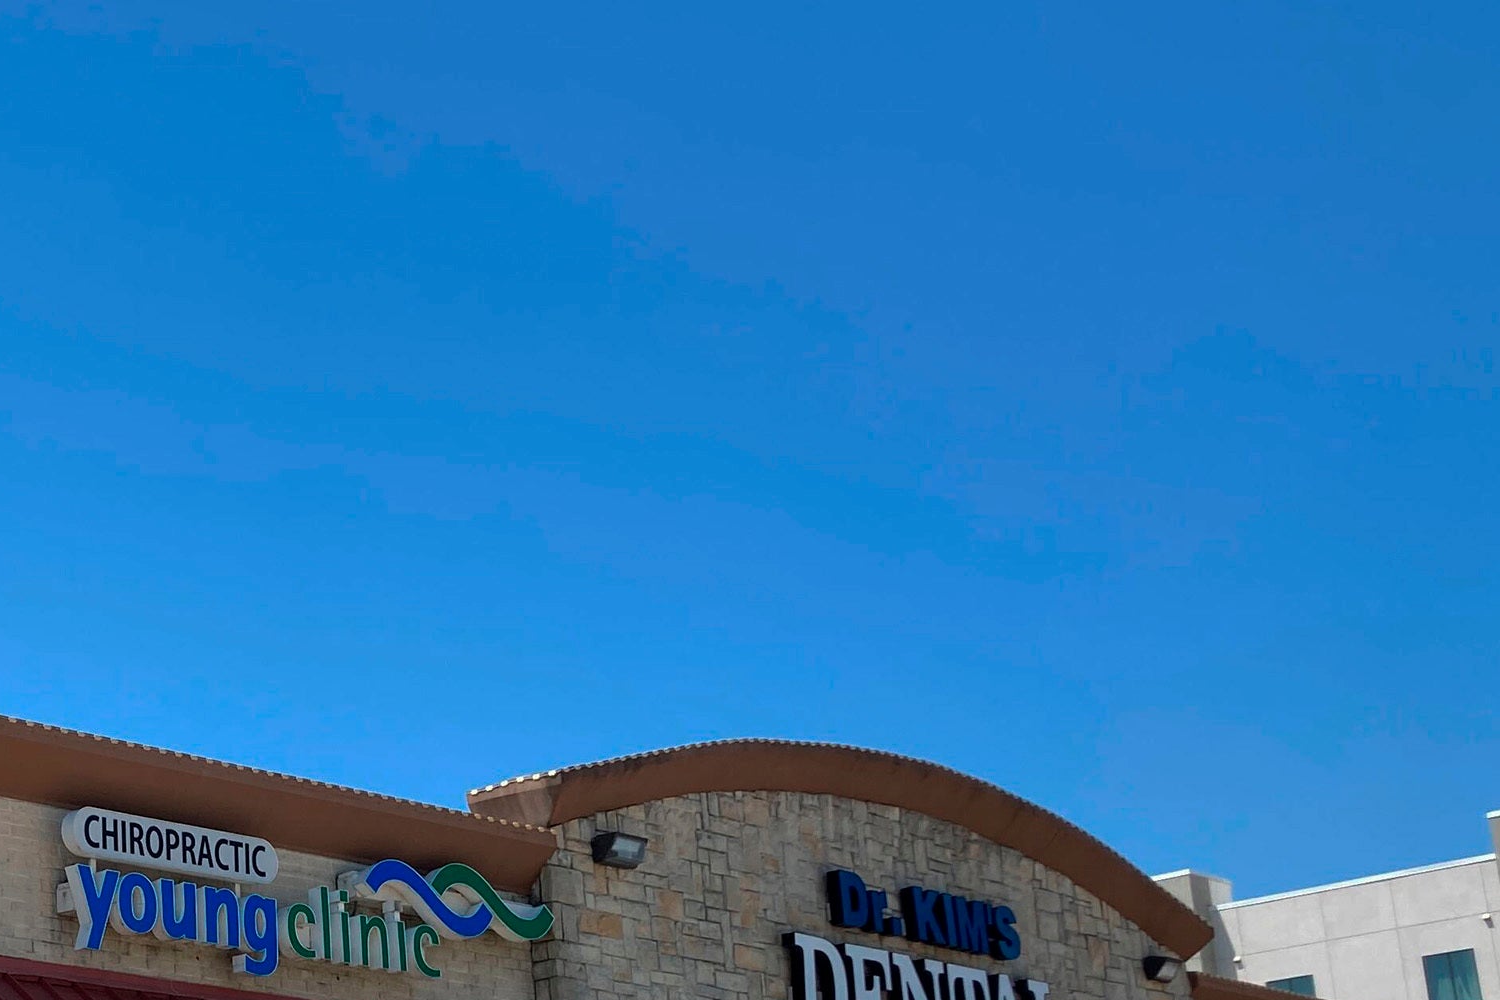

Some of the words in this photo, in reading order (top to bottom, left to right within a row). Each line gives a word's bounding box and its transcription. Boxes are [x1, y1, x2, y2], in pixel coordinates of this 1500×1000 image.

[84, 814, 267, 878] CHIROPRACTIC
[827, 869, 899, 938] Dr.
[901, 885, 1022, 960] KIM'S
